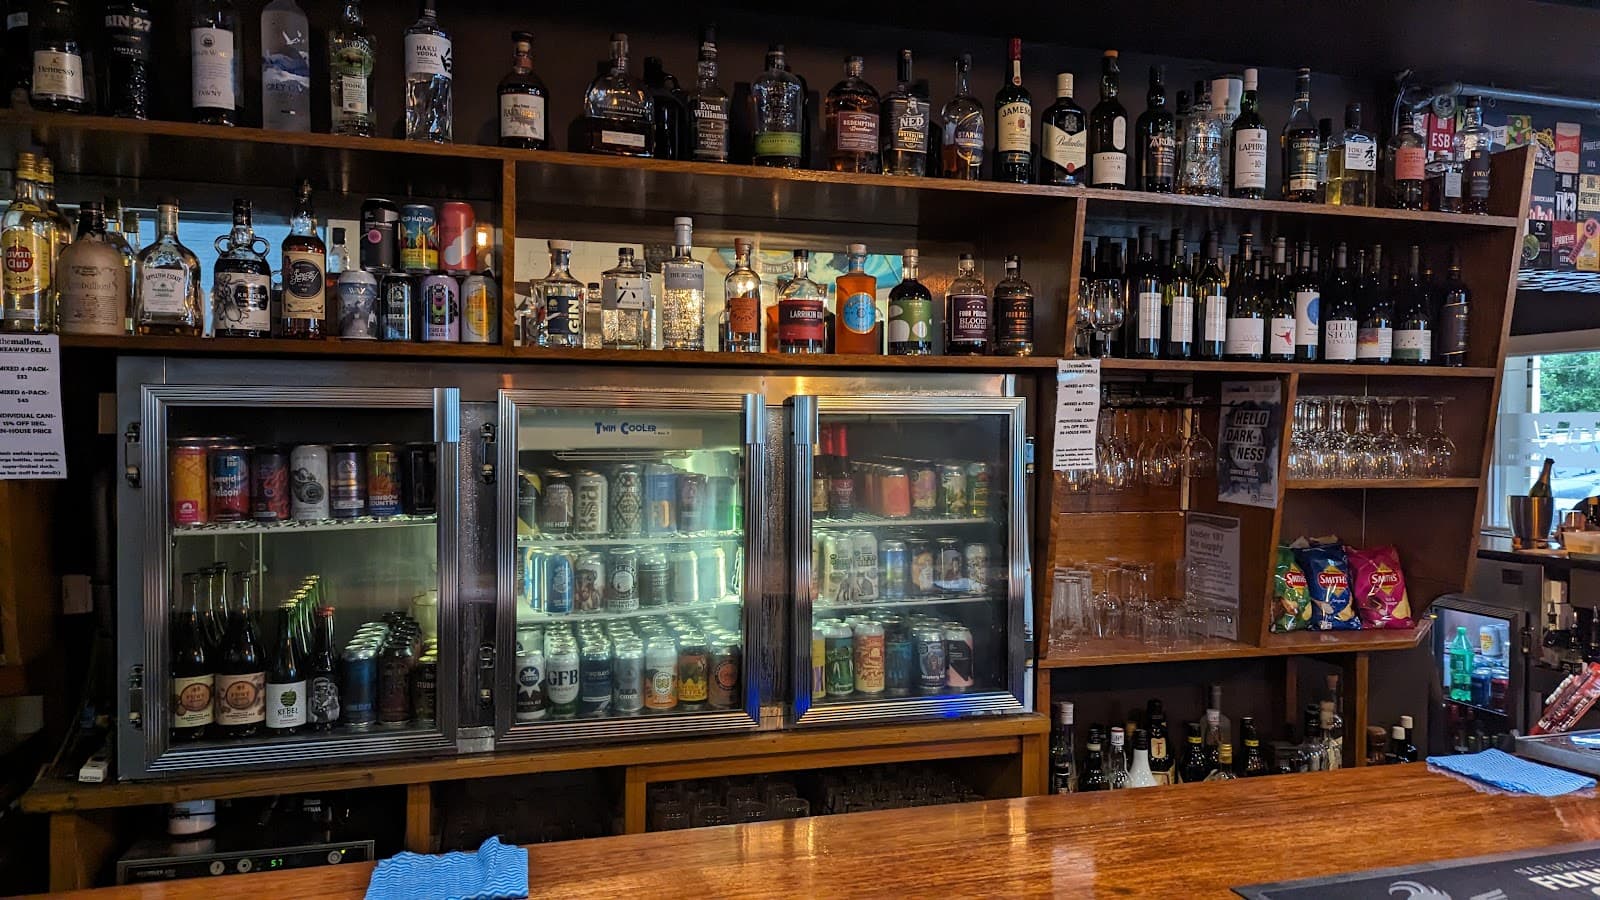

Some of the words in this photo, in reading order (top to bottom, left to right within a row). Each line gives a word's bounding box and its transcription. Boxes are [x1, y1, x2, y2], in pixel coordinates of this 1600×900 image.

[133, 17, 152, 32] 27
[699, 102, 721, 111] Evan
[694, 109, 728, 120] Williams
[900, 117, 923, 128] NED
[1431, 132, 1450, 148] ESB
[7, 260, 29, 269] Club
[568, 299, 580, 334] GIN
[789, 309, 816, 319] LARRIKIN
[1235, 411, 1268, 426] HELLO
[594, 422, 616, 435] TWIN
[620, 422, 657, 435] COOLER
[1226, 429, 1257, 443] DARK-
[1235, 447, 1264, 461] NESS
[547, 670, 578, 686] GFB
[271, 858, 284, 867] 57
